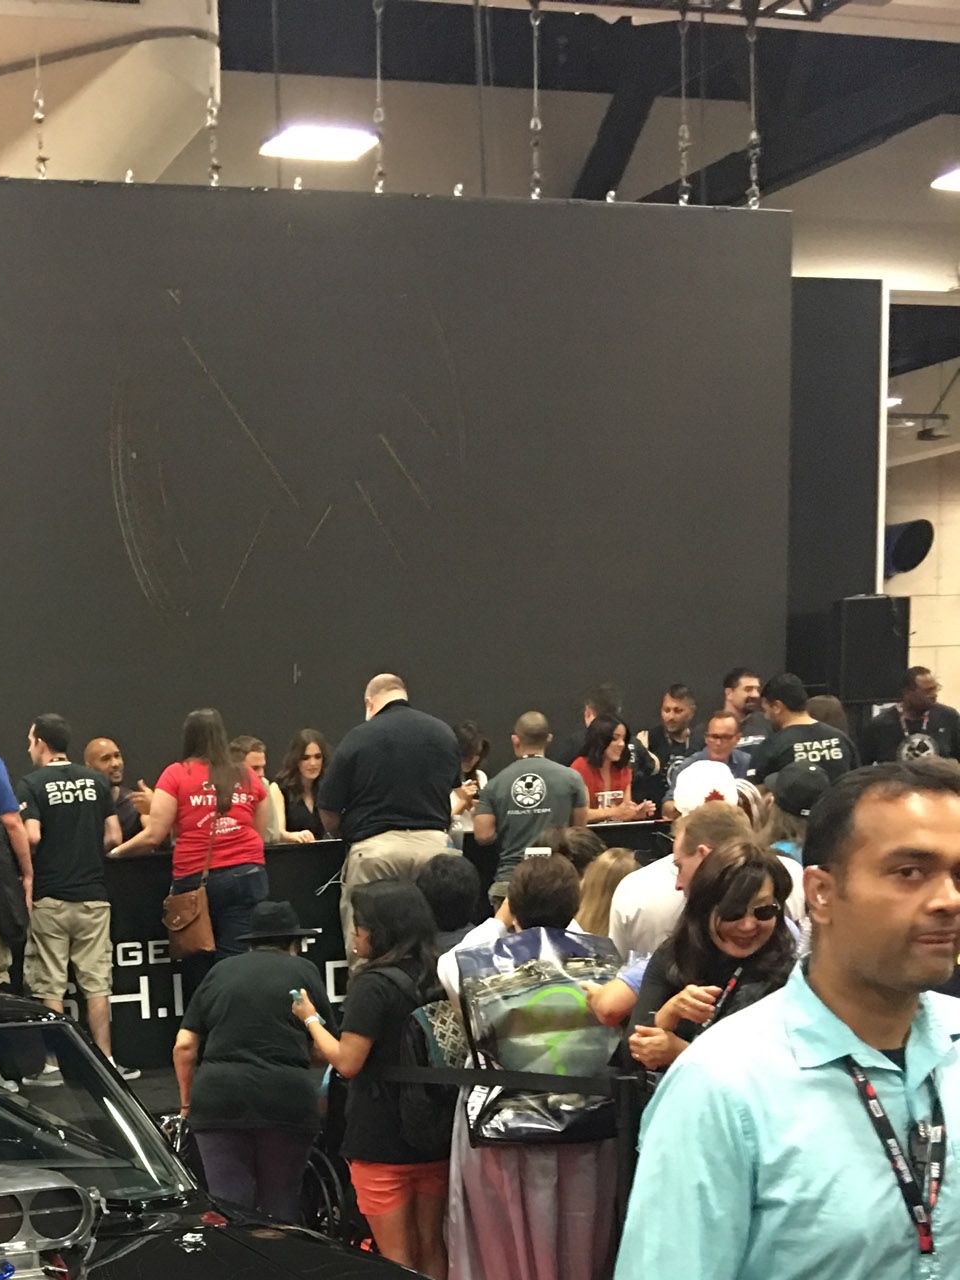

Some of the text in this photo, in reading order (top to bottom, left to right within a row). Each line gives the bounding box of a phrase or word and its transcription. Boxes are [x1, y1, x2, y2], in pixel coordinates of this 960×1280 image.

[793, 738, 840, 752] STAFF
[794, 747, 843, 762] 2016
[45, 779, 95, 792] STAFF
[48, 788, 97, 806] 2016
[189, 792, 254, 807] WITSS?
